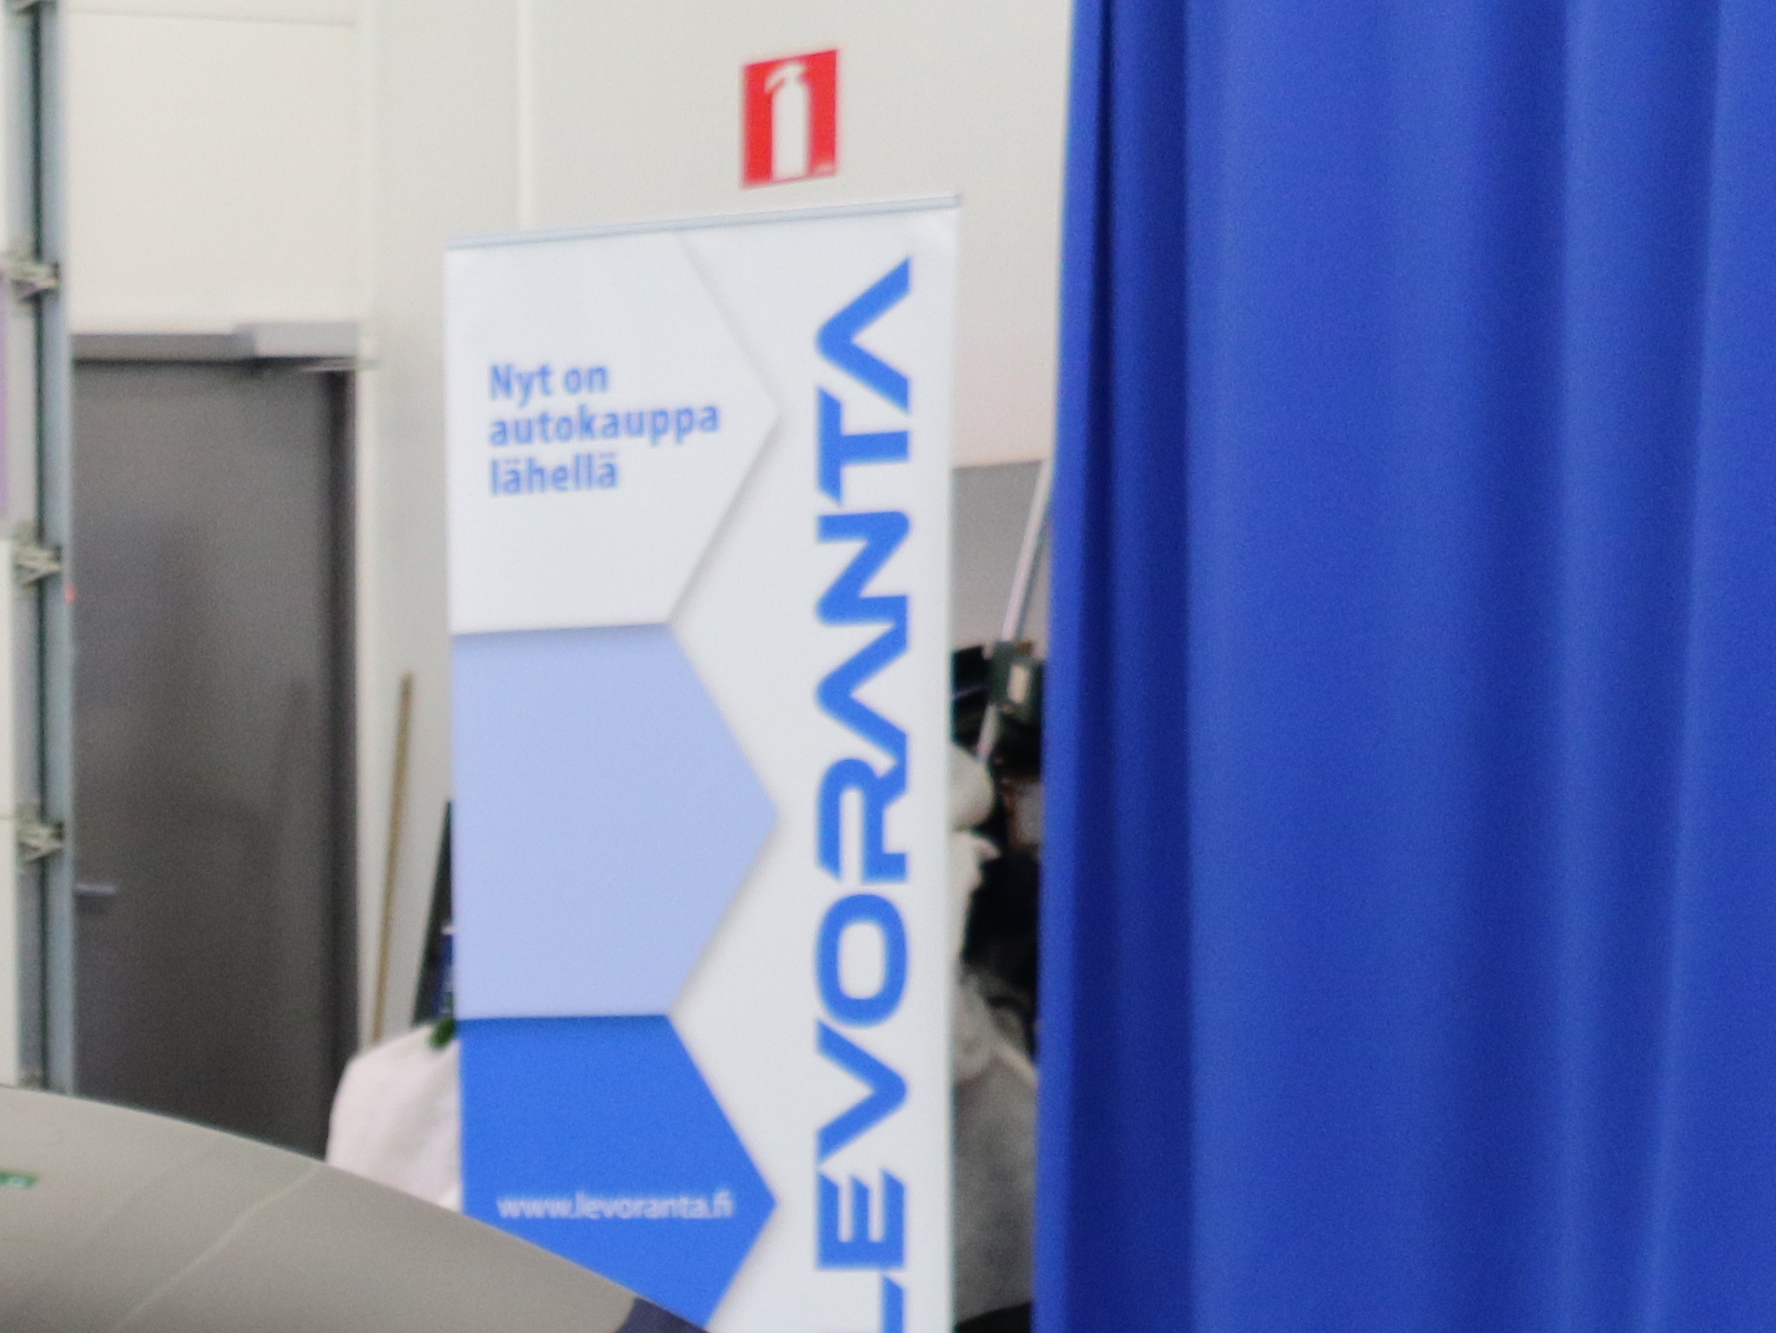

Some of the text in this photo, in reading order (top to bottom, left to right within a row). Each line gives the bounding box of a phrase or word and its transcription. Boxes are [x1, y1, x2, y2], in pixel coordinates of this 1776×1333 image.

[490, 363, 609, 408] Nyt on
[490, 403, 722, 446] autokauppa
[490, 451, 619, 496] lähellä
[497, 1189, 733, 1219] www.levoranta.fi
